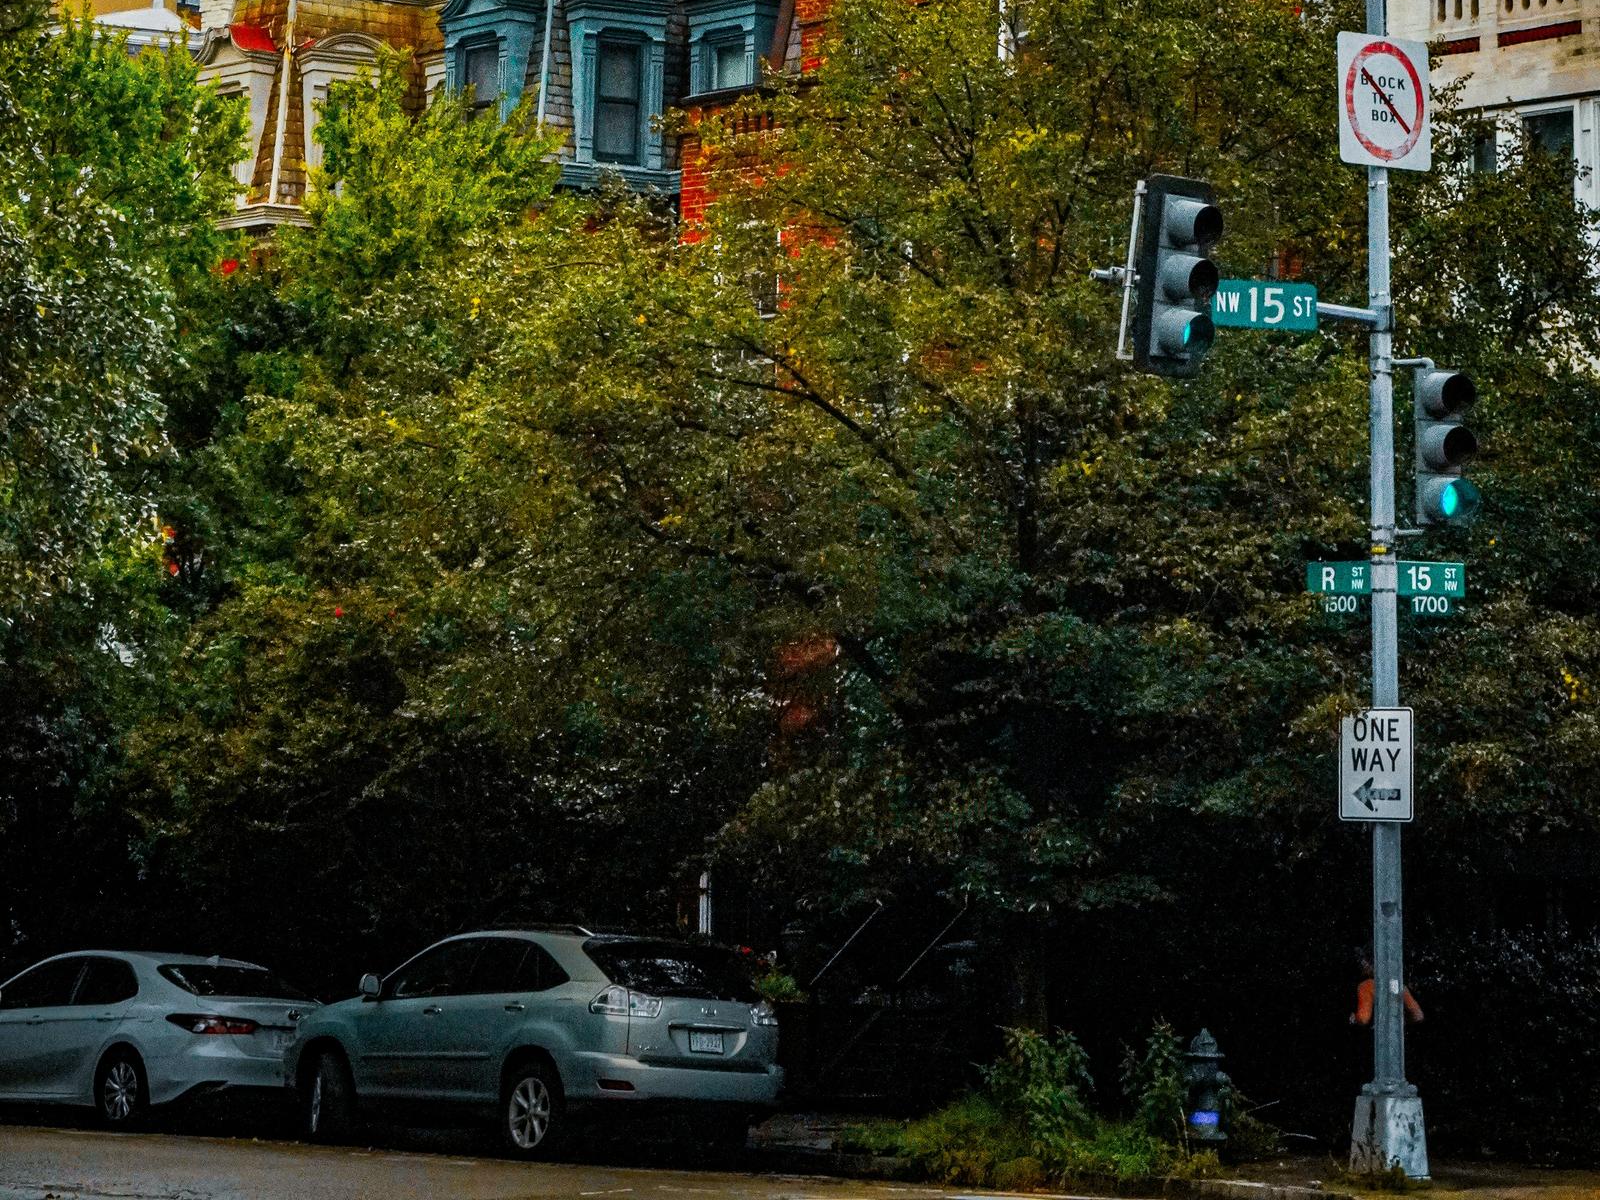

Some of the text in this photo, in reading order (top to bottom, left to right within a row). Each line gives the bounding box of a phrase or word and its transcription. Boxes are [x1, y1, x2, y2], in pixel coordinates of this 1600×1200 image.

[1371, 110, 1396, 123] BOX
[1216, 287, 1313, 324] NW 15 ST
[1321, 567, 1336, 591] R
[1351, 567, 1364, 577] ST
[1407, 566, 1432, 591] 15
[1444, 568, 1457, 579] ST
[1351, 579, 1364, 590] NW
[1444, 581, 1458, 592] NW
[1325, 595, 1357, 613] 1500
[1413, 596, 1448, 613] 1700
[1353, 718, 1400, 742] ONE
[1351, 748, 1401, 772] WAY
